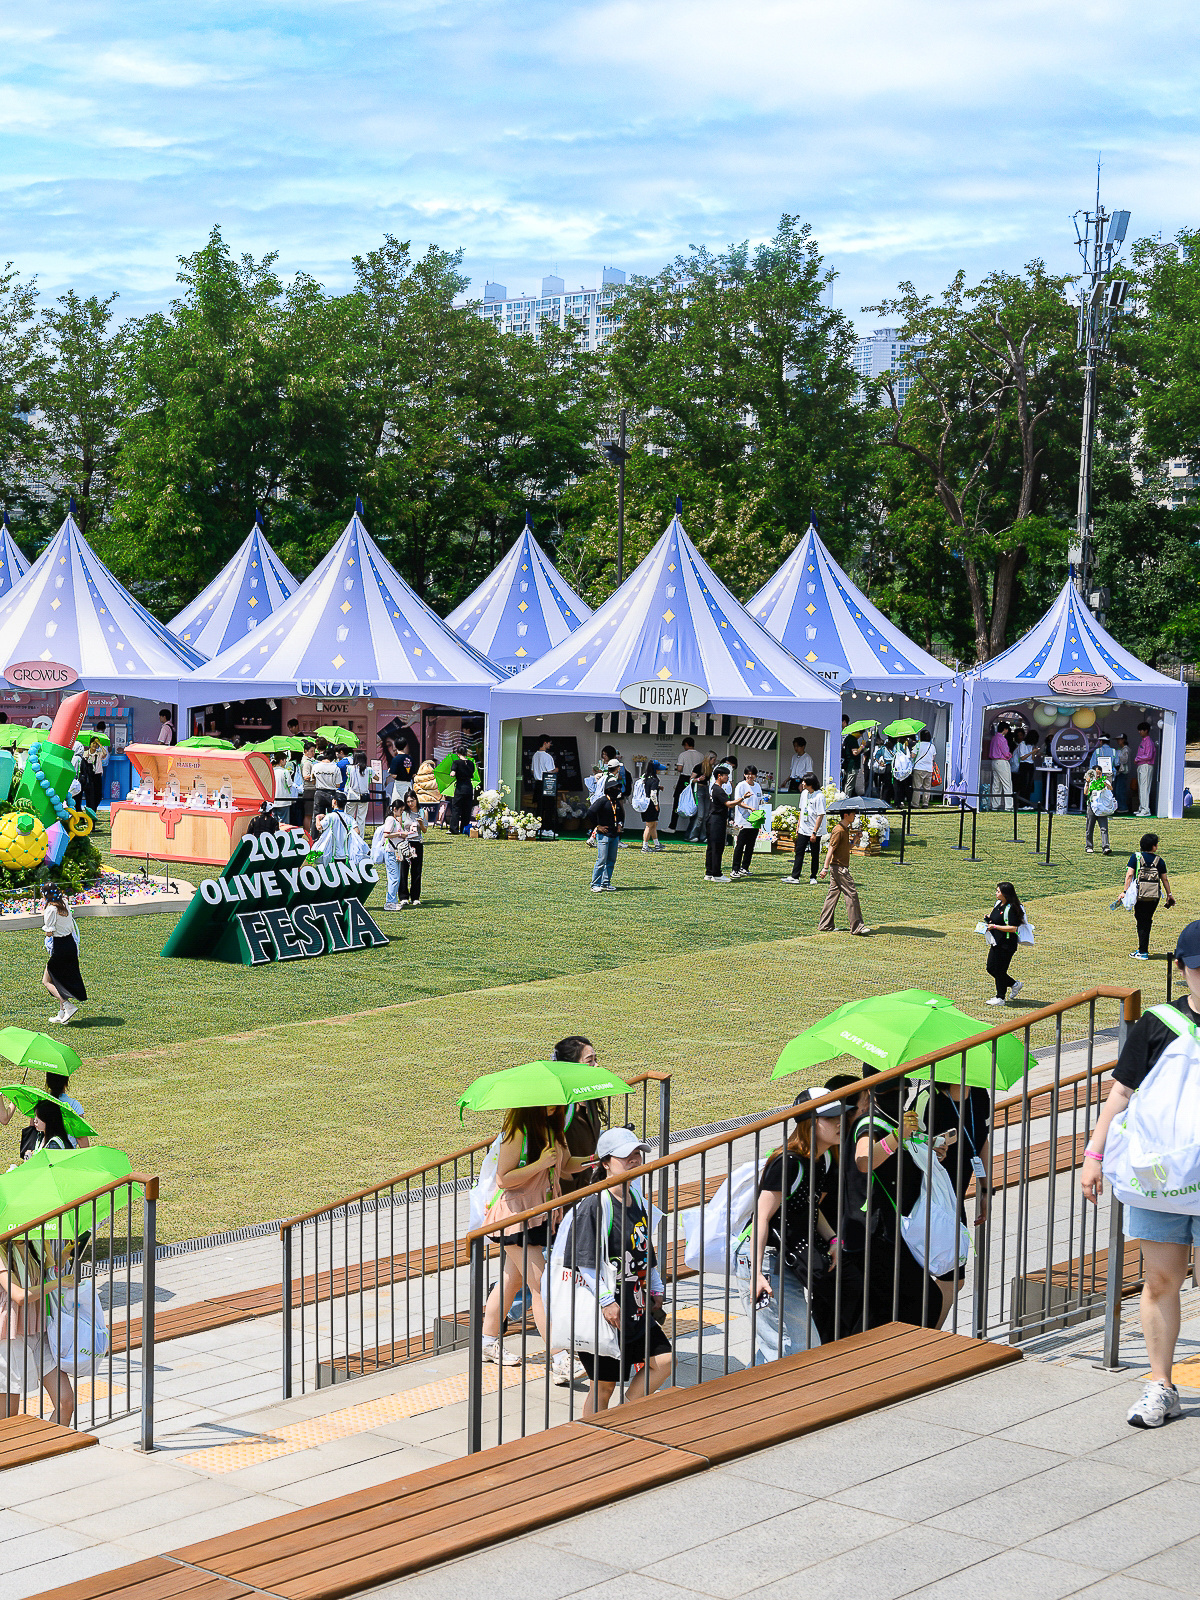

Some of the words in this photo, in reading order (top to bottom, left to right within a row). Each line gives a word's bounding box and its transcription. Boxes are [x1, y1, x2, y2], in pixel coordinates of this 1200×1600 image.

[13, 669, 68, 682] GROWUS
[1085, 680, 1102, 688] Faye
[296, 678, 372, 697] UNOVE
[639, 686, 689, 706] D'ORSAY
[315, 704, 349, 713] UNOVE
[242, 828, 311, 862] 2025
[199, 870, 282, 905] OLIVE
[279, 858, 380, 894] YOUNG
[236, 896, 390, 965] FESTA
[839, 1029, 864, 1047] OLIVE
[862, 1040, 889, 1059] YOUNG
[27, 1058, 42, 1066] OLIVE
[42, 1061, 58, 1069] YOUNG
[572, 1085, 591, 1095] OLIVE
[590, 1081, 613, 1092] YOUNG
[1130, 1177, 1158, 1199] OLVE
[1161, 1181, 1200, 1198] YOUN
